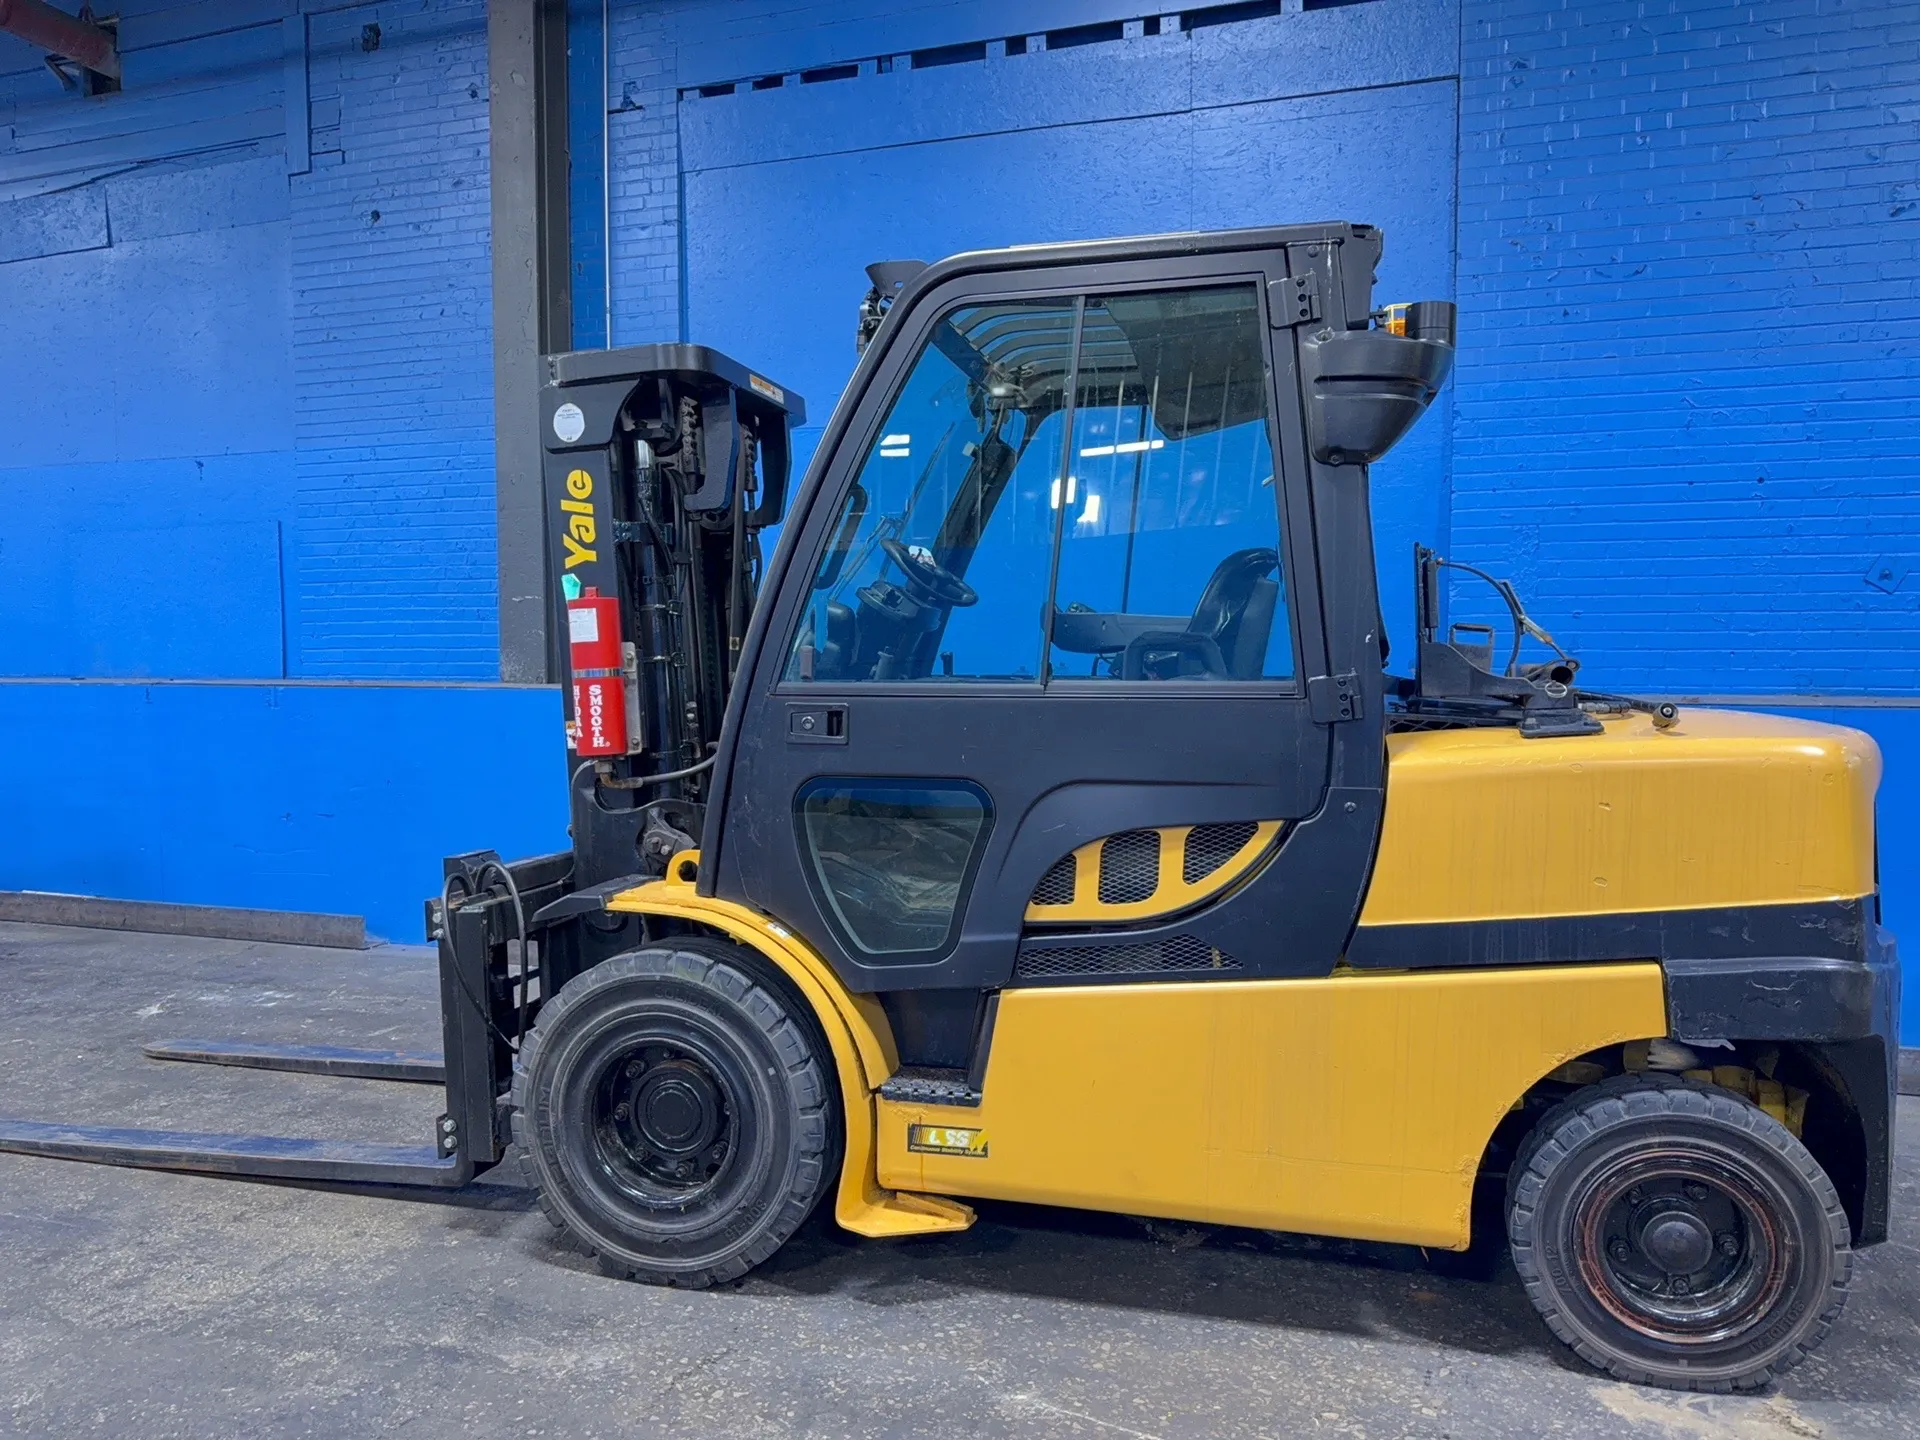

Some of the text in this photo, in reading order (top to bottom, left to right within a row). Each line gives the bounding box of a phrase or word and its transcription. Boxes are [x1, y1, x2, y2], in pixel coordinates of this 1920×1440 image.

[561, 469, 597, 569] Yale
[573, 685, 583, 738] HYDRA
[589, 684, 605, 748] SMOOTH
[941, 1147, 964, 1155] Stability
